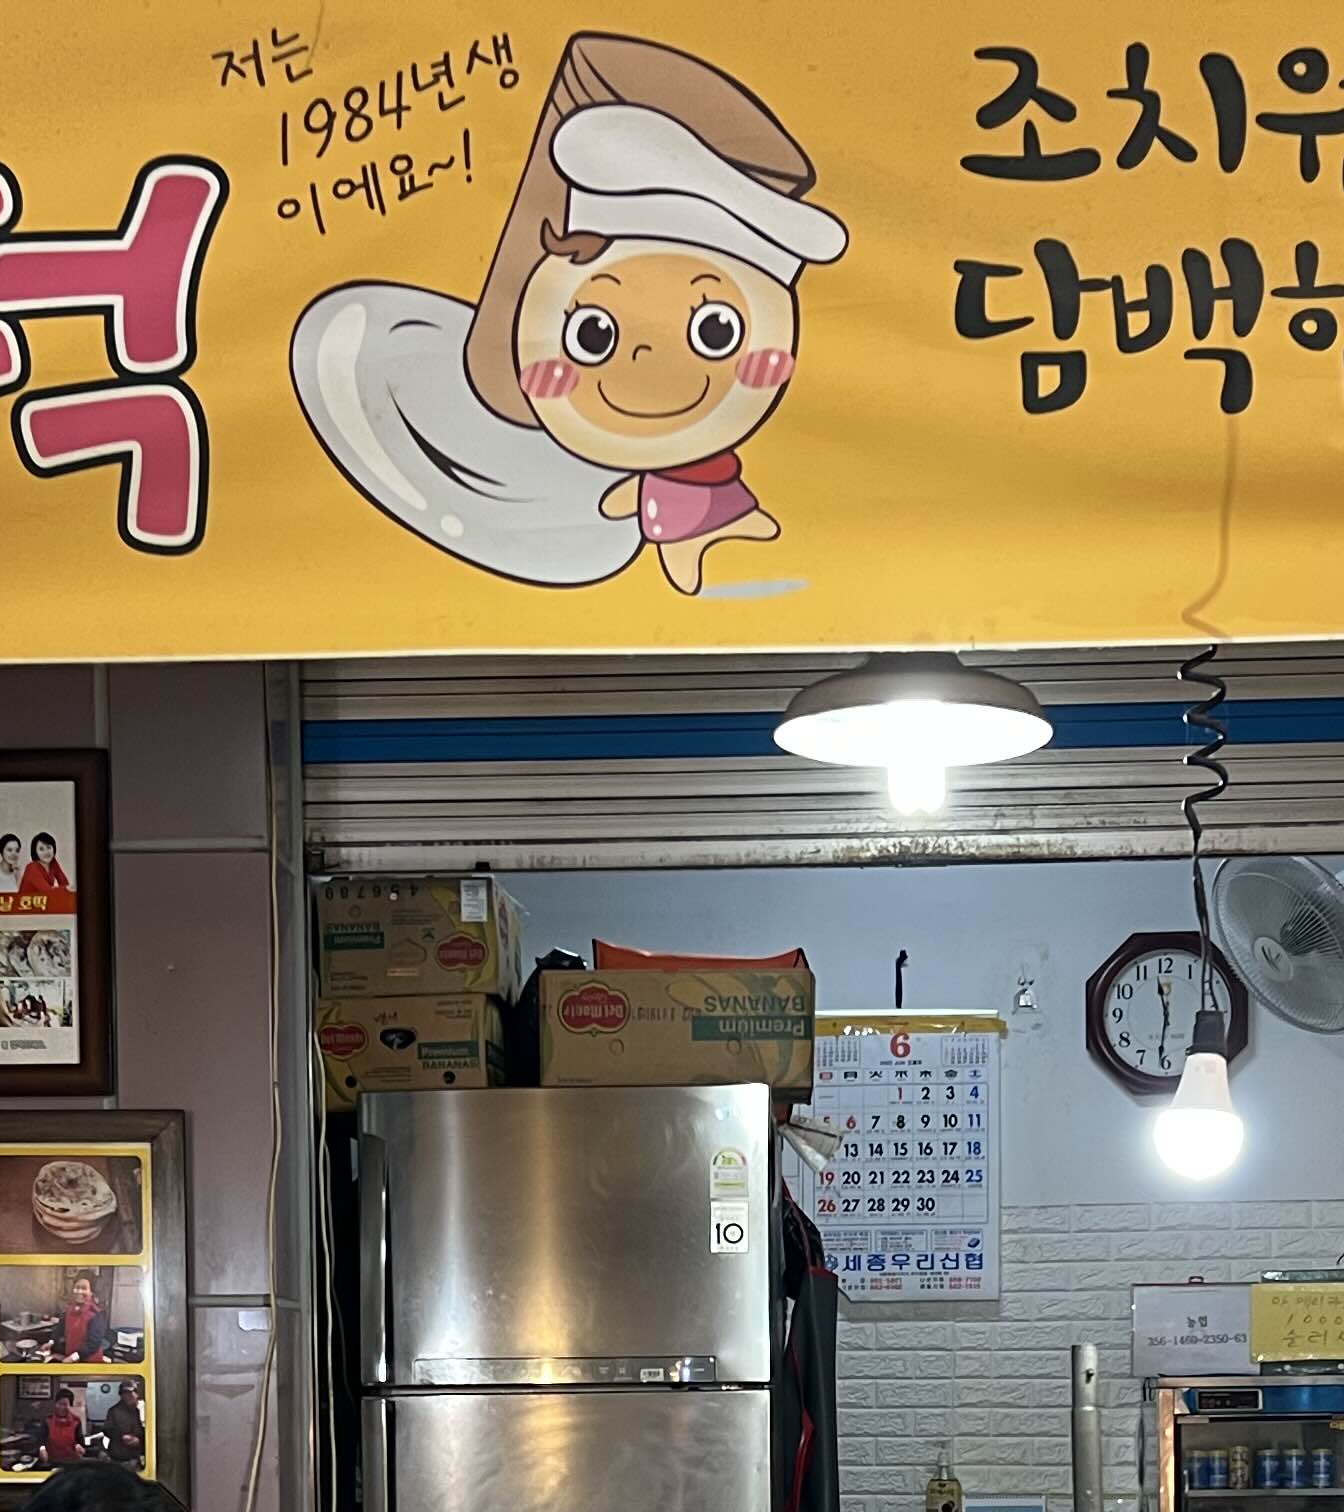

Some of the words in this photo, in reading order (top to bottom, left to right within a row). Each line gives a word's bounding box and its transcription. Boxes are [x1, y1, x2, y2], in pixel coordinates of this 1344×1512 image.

[212, 28, 314, 86] 저는
[278, 32, 520, 166] 1984년생
[19, 895, 48, 912] 호떡
[1136, 965, 1148, 981] 11
[1157, 958, 1173, 974] 12
[1187, 964, 1193, 980] 1
[1116, 983, 1133, 1000] 10
[704, 996, 805, 1013] BANANAS
[1112, 1007, 1123, 1023] 9
[719, 1019, 805, 1036] Premium
[890, 1032, 911, 1058] 6
[1119, 1032, 1130, 1048] 8
[1136, 1049, 1146, 1066] 7
[1161, 1054, 1171, 1070] 6
[897, 1087, 903, 1100] 1
[921, 1087, 930, 1100] 2
[946, 1087, 955, 1100] 3
[969, 1087, 979, 1100] 4
[846, 1115, 856, 1129] 6
[871, 1115, 880, 1129] 7
[896, 1115, 905, 1129] 8
[921, 1115, 930, 1129] 9
[943, 1115, 958, 1129] 10
[968, 1115, 981, 1129] 11
[844, 1143, 858, 1157] 13
[869, 1143, 884, 1157] 14
[894, 1143, 908, 1157] 15
[918, 1143, 933, 1157] 16
[943, 1143, 957, 1157] 17
[968, 1143, 981, 1157] 18
[819, 1171, 834, 1185] 19
[842, 1171, 860, 1185] 20
[869, 1171, 884, 1185] 21
[892, 1171, 910, 1185] 22
[917, 1171, 935, 1185] 23
[941, 1171, 959, 1185] 24
[966, 1171, 983, 1185] 25
[818, 1199, 836, 1212] 26
[842, 1199, 860, 1212] 27
[868, 1199, 885, 1212] 28
[892, 1199, 910, 1212] 29
[917, 1199, 935, 1212] 30
[842, 1253, 984, 1272] 세종우리신협
